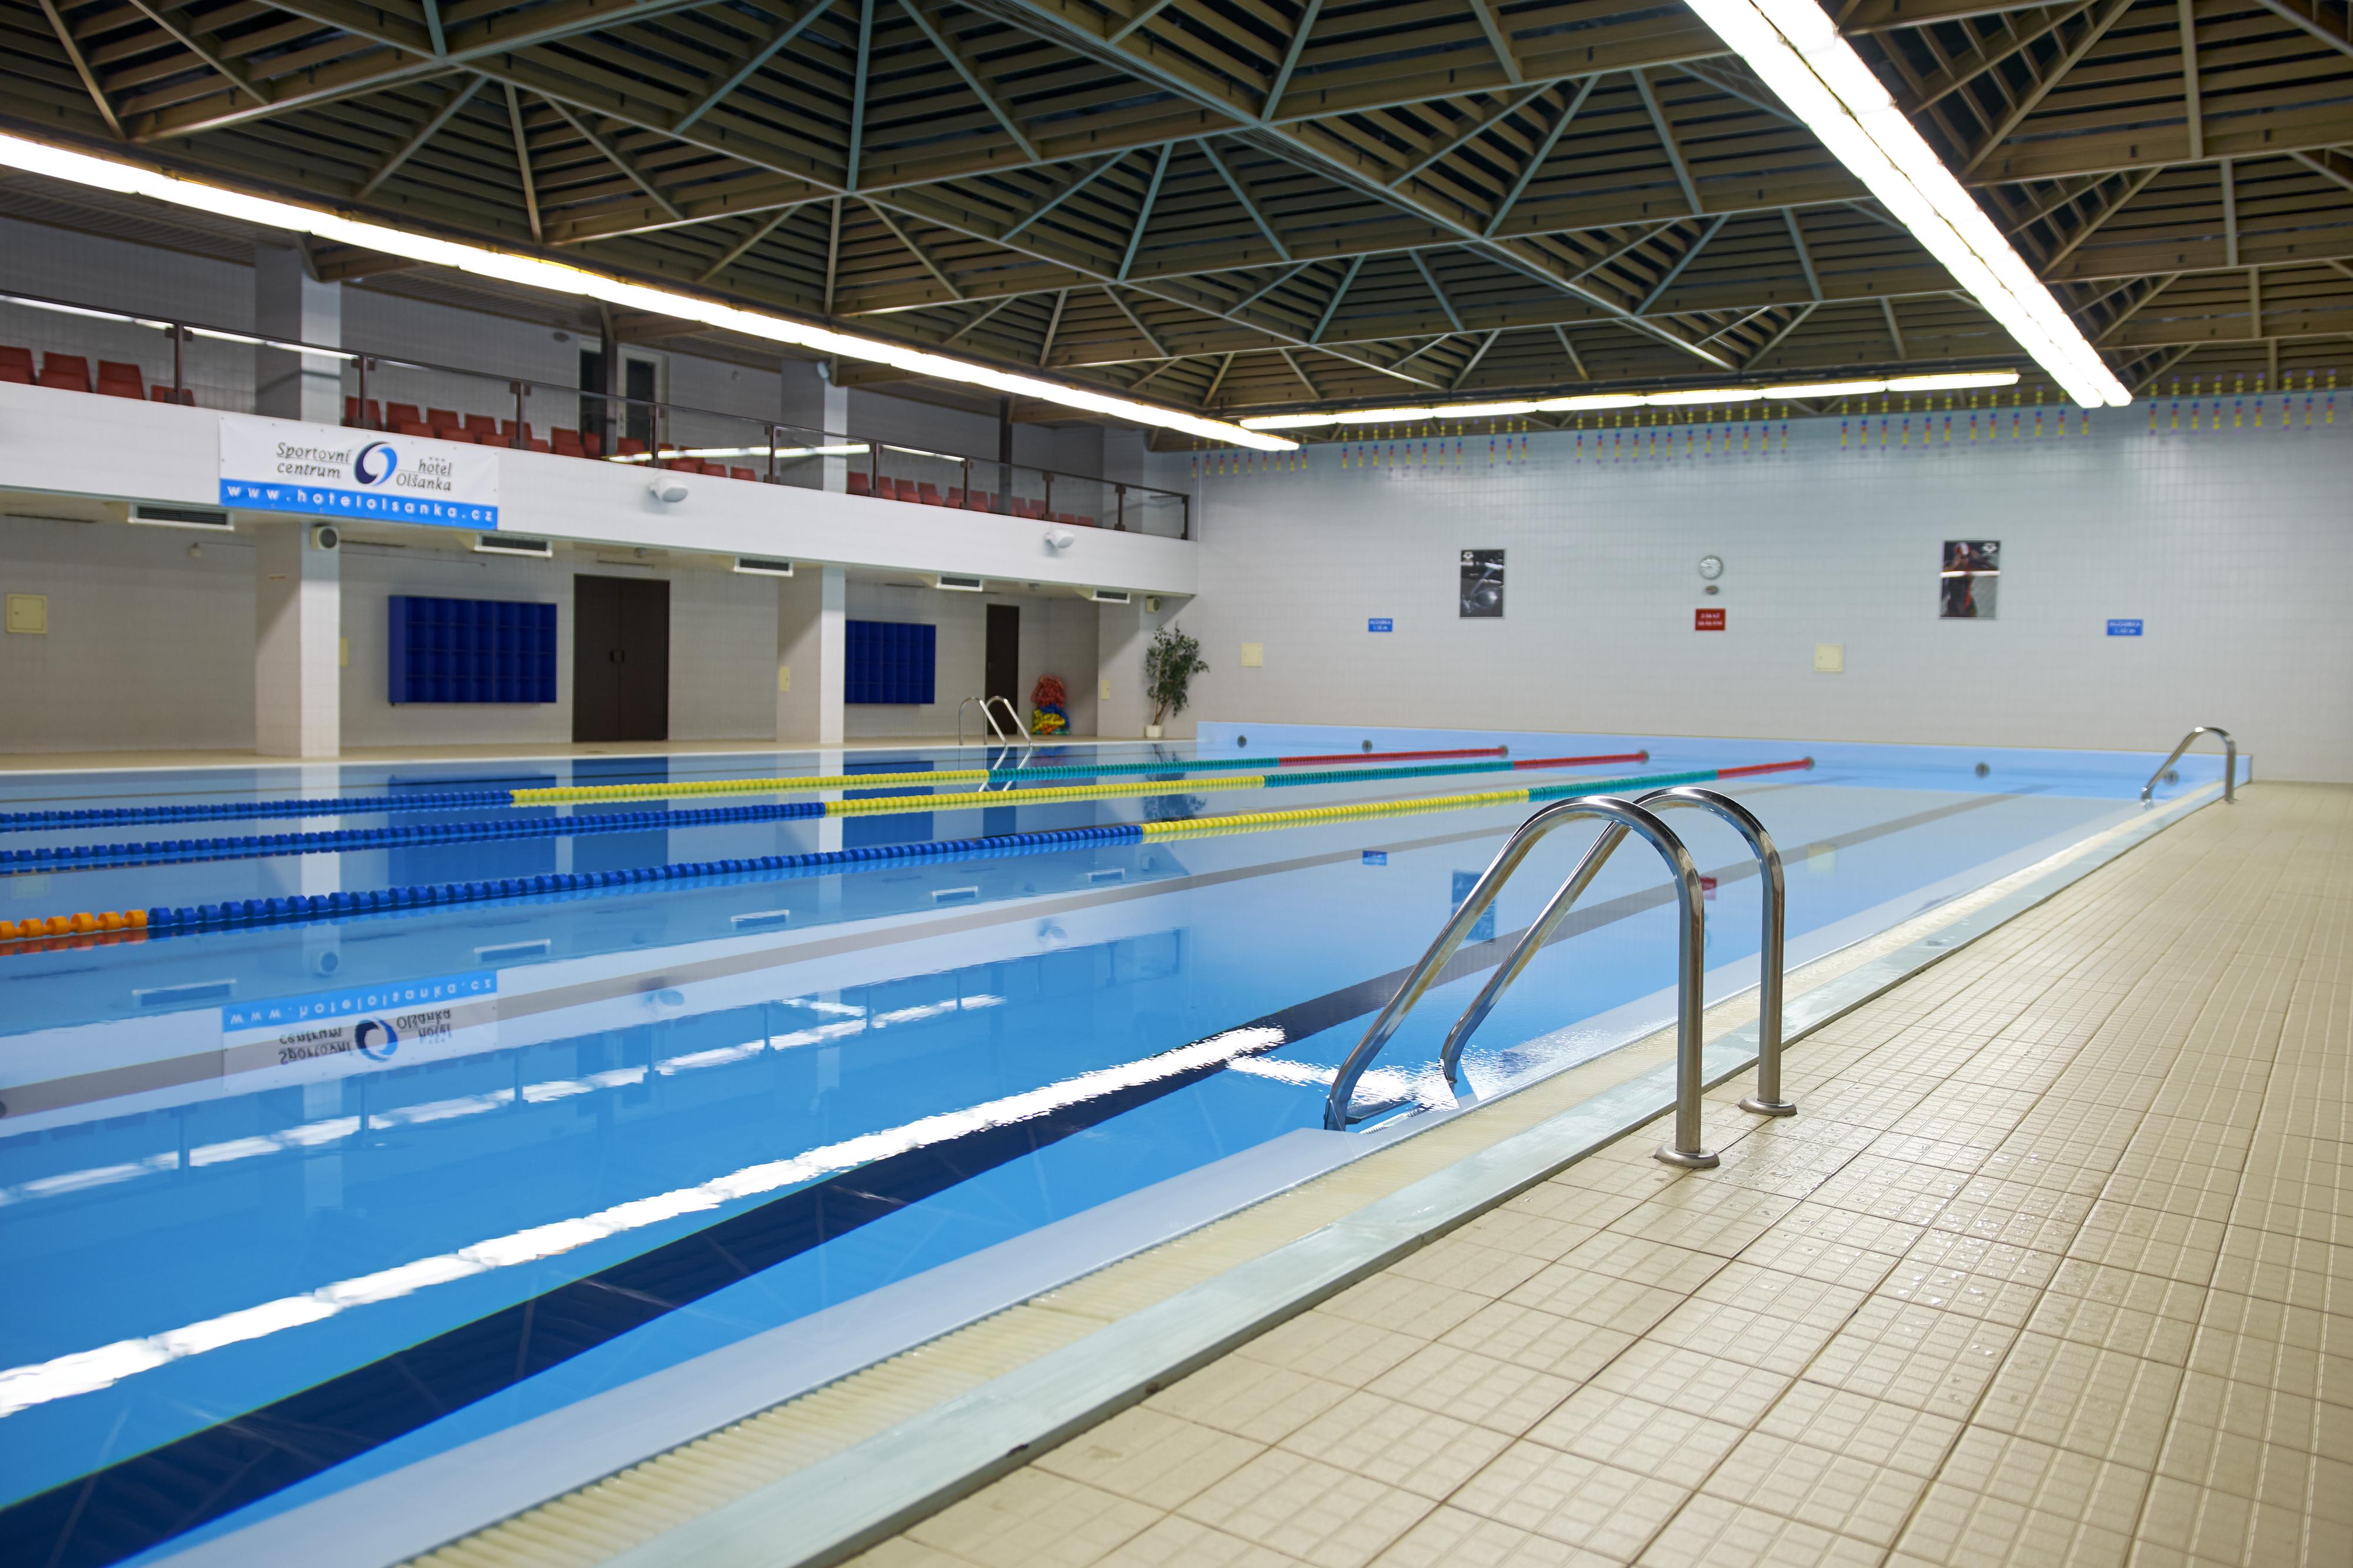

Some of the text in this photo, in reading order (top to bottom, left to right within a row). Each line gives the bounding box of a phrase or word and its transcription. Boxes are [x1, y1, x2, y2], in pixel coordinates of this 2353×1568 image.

[276, 442, 351, 462] Sportovní
[277, 462, 340, 478] centrum
[418, 458, 452, 475] hotel
[396, 472, 451, 491] Olšanka
[227, 485, 492, 522] www.hotelolsanka.cz
